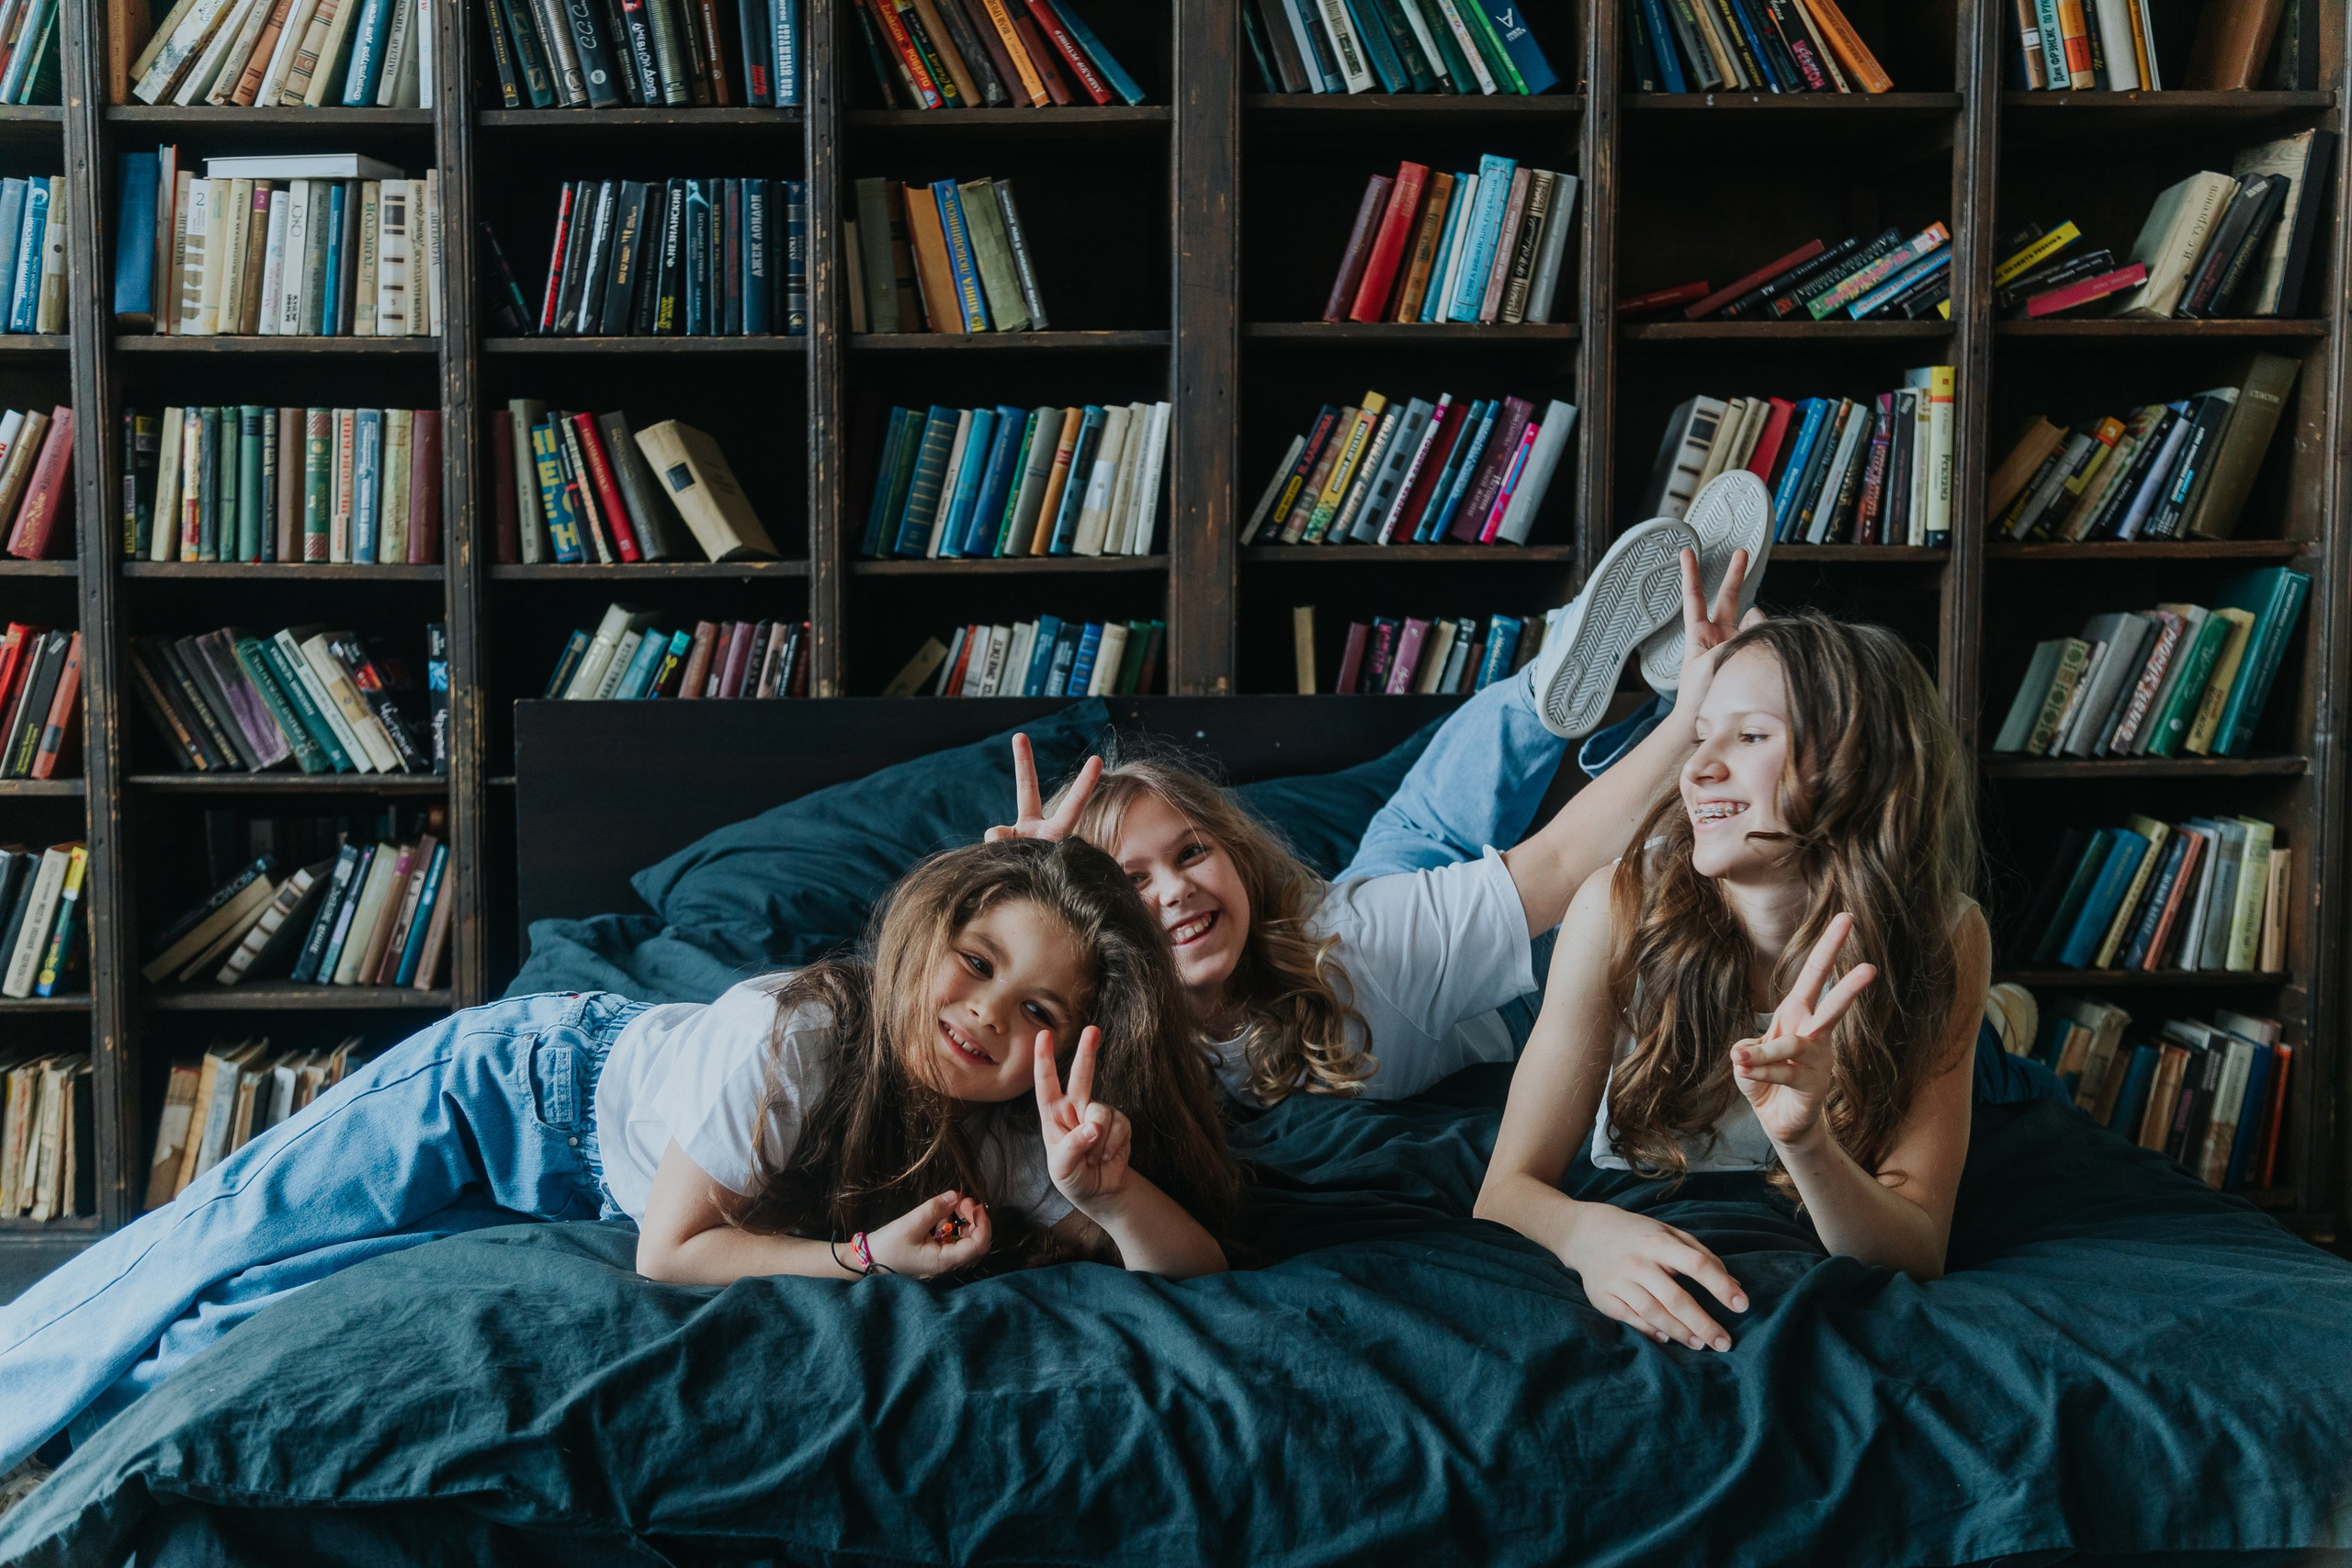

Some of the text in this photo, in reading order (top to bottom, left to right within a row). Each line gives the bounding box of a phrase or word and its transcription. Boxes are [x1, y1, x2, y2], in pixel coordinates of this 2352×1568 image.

[352, 3, 378, 101] Физкультура для всей
[777, 24, 793, 76] СТРАШНЫЙ
[880, 3, 932, 88] САМСОН РОБЕРТО
[2045, 27, 2062, 65] ФРЭНСИС
[175, 211, 187, 267] ЛИТЕРАТУРА
[363, 203, 376, 267] ТОЛСТОЙ
[664, 188, 683, 267] Ф.НЕЗНАНСКИЙ
[750, 194, 763, 276] ДЖЕК ЛОНДОН
[944, 199, 980, 314] КНИГА ЛЮБОВНИКОВ
[1465, 273, 1476, 298] КНИГА
[340, 417, 352, 513] ШКЛОВСКИЙ
